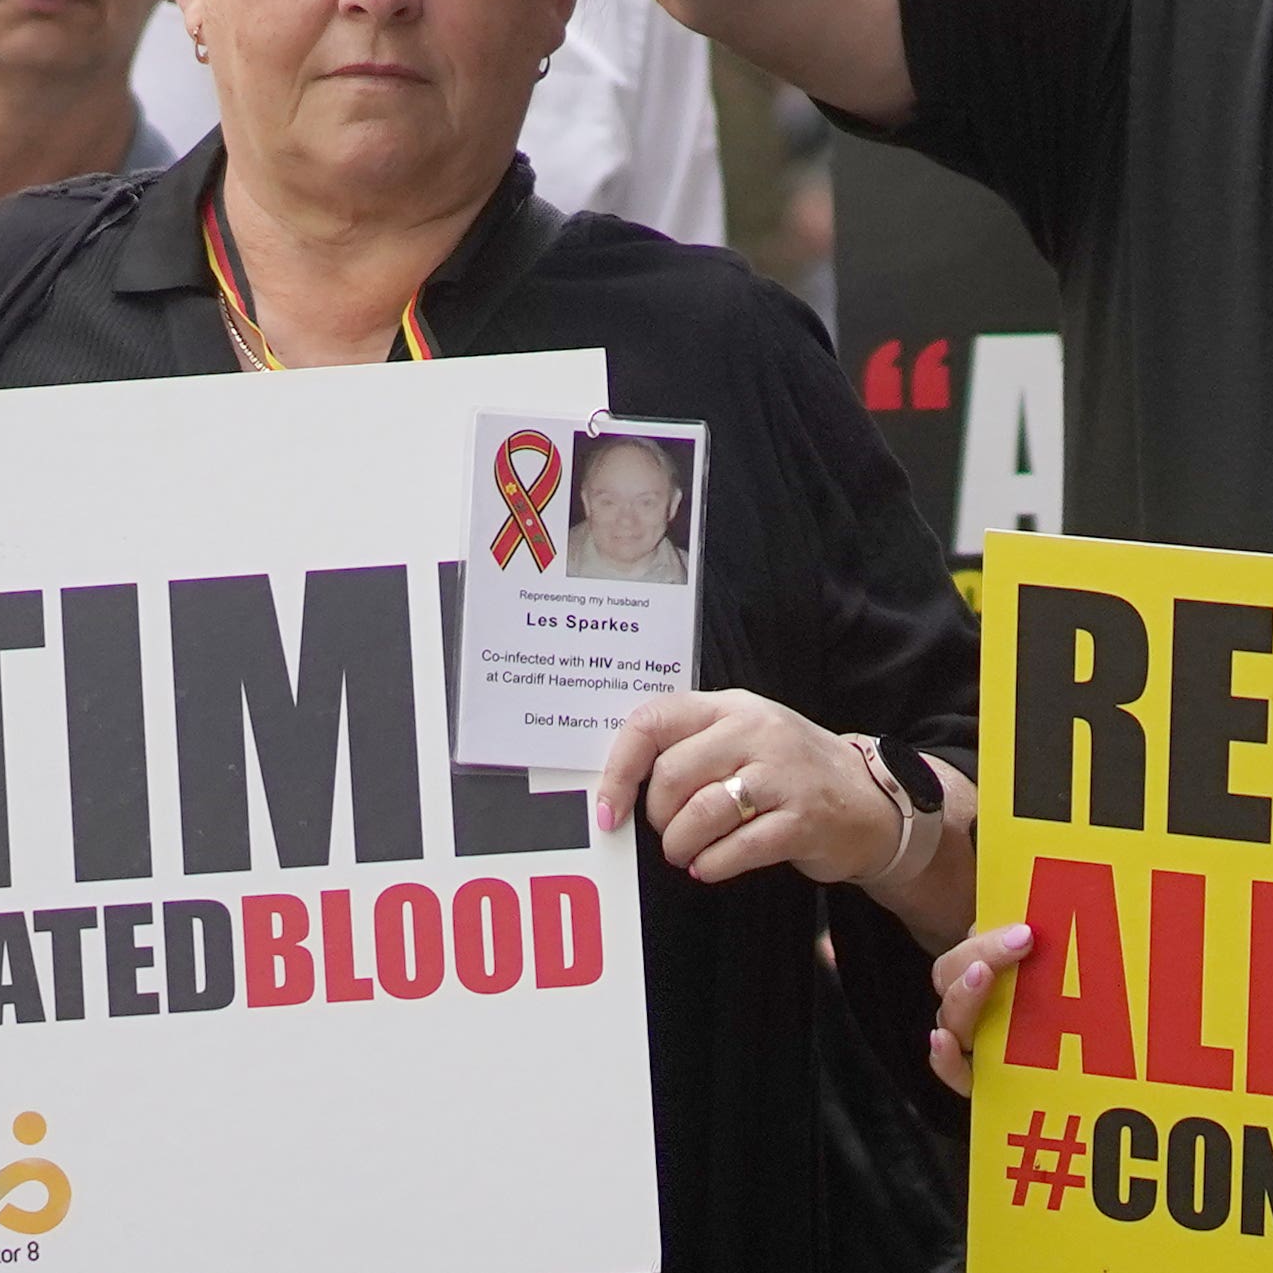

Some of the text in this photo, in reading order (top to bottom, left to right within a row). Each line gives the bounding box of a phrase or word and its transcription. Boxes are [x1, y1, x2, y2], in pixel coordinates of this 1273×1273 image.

[519, 589, 650, 608] Representing my husband
[526, 612, 640, 633] Les Sparkes
[481, 649, 681, 675] Co-infected with HIV and HepC
[486, 671, 675, 693] at Cardiff Haemophilia Centre
[524, 712, 627, 729] Died March 199
[27, 1241, 39, 1261] 8
